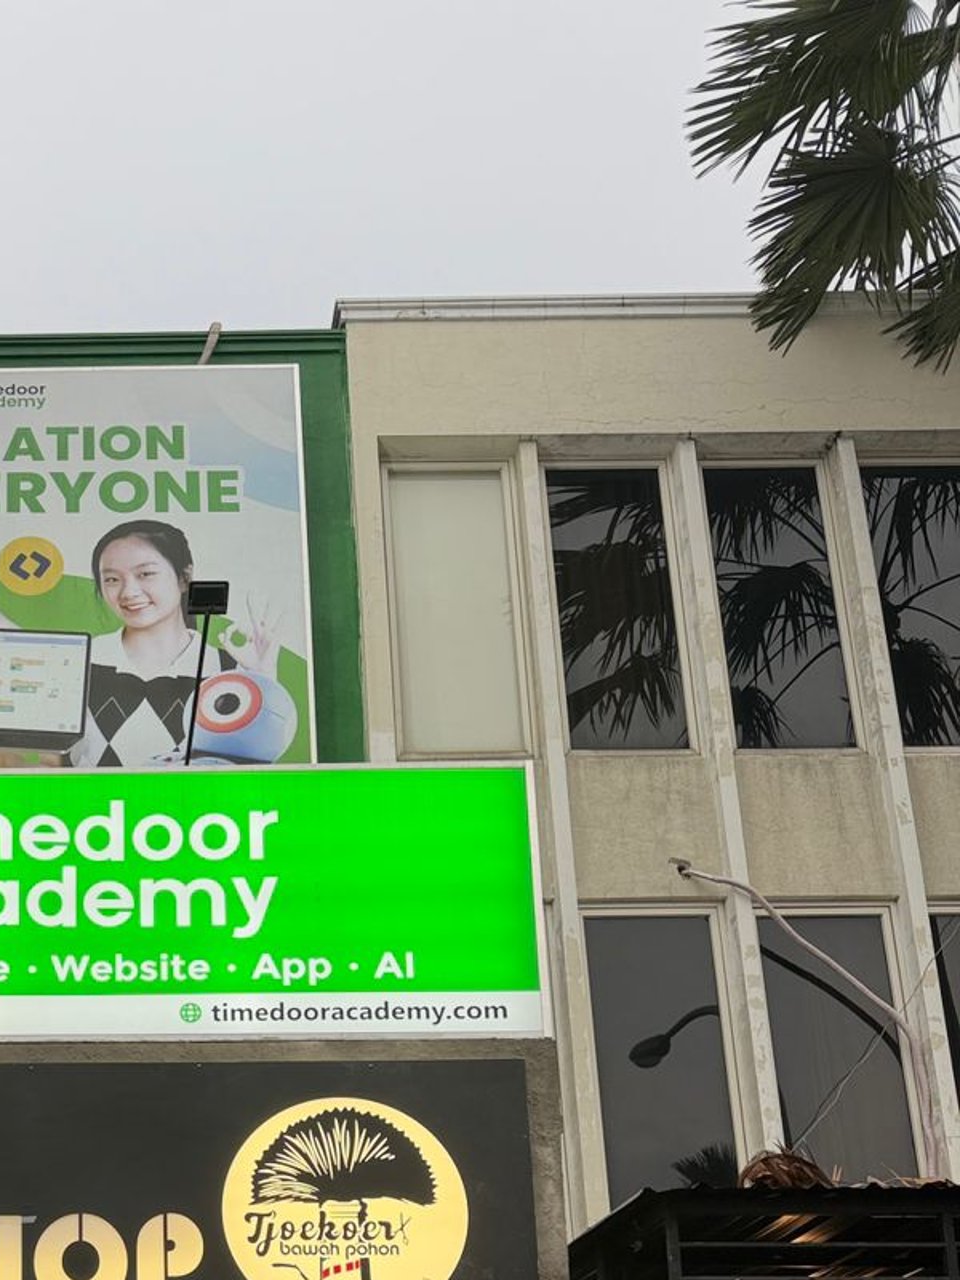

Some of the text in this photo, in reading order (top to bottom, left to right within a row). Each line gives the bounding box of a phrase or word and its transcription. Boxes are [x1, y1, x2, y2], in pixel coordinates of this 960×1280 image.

[50, 953, 211, 982] Website
[251, 952, 333, 986] App
[373, 951, 415, 979] AI
[211, 1000, 508, 1026] timedooracademy.com
[244, 1211, 396, 1257] Tjoekoer
[280, 1240, 400, 1259] bawah pohon
